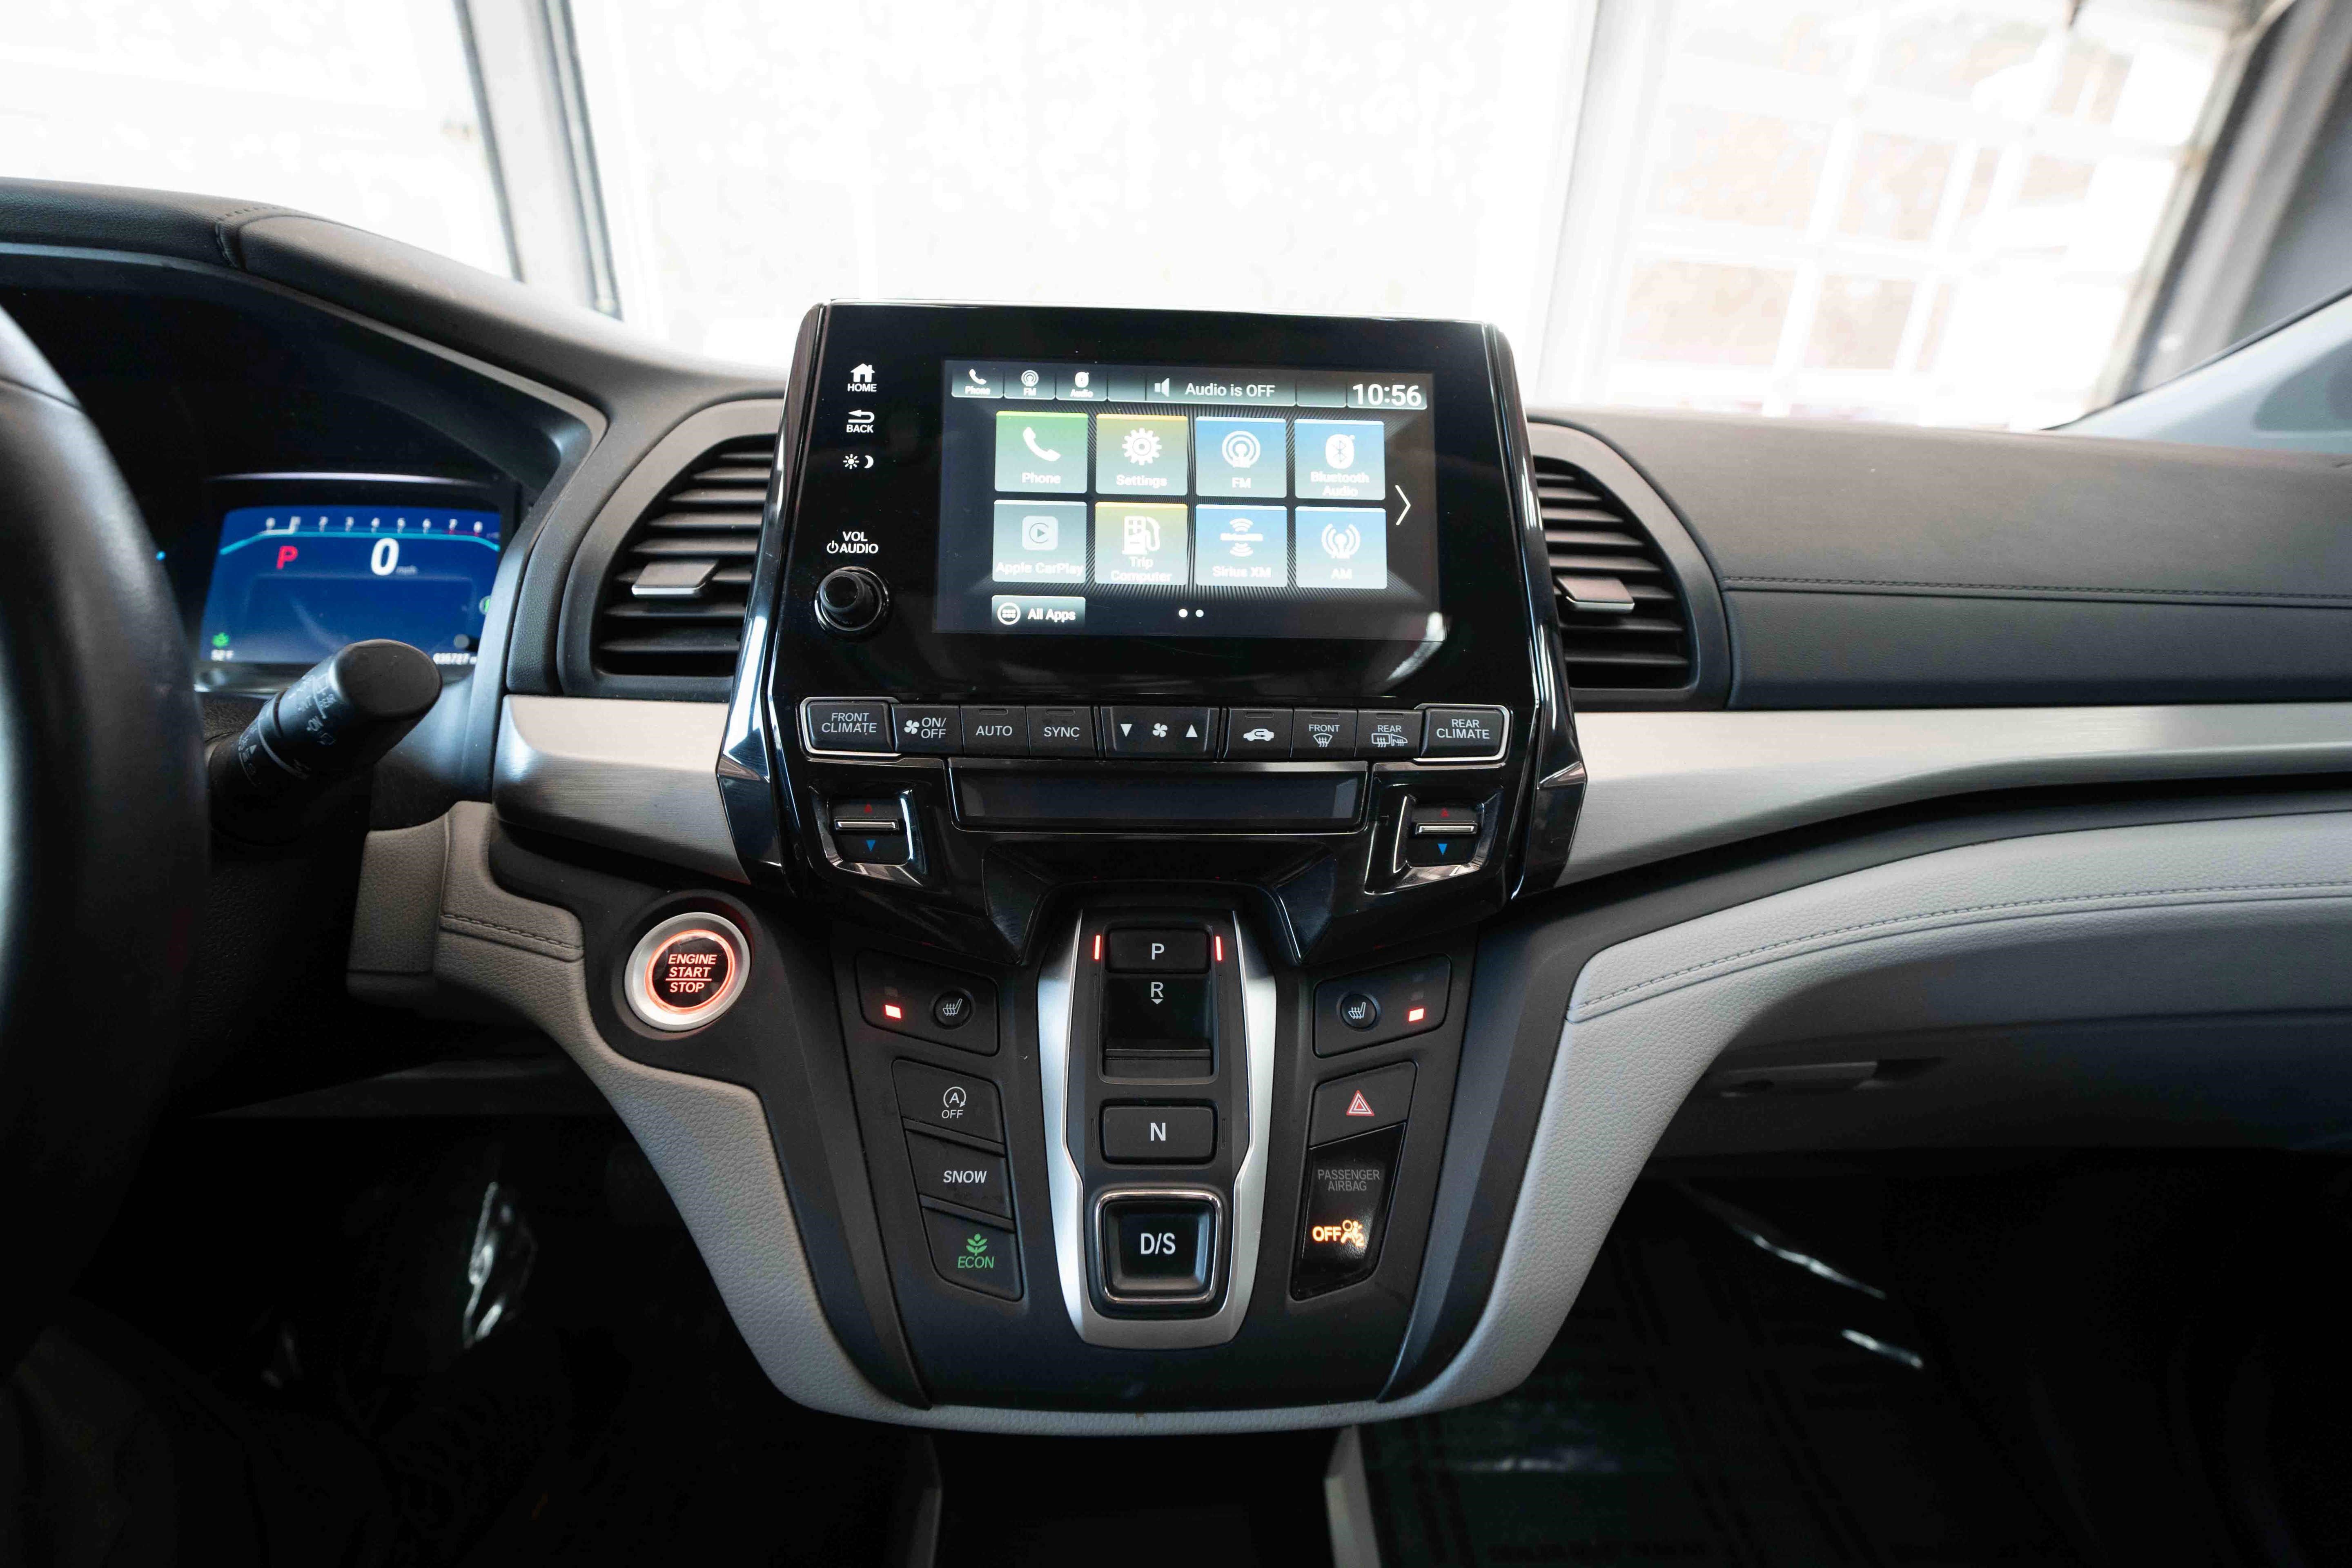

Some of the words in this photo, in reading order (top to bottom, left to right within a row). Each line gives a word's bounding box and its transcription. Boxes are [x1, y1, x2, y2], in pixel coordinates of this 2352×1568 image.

[847, 383, 877, 392] HOME
[964, 385, 991, 395] Phone
[1023, 388, 1036, 396] FM
[1185, 383, 1227, 396] Audio
[1230, 384, 1242, 396] is
[1246, 384, 1275, 397] OFF
[1069, 389, 1094, 399] Audio
[1352, 383, 1422, 406] 10:56
[846, 424, 874, 433] BACK
[1022, 472, 1061, 484] Phone
[1116, 474, 1167, 488] Settings
[1232, 477, 1252, 488] FM
[1310, 471, 1370, 484] Bluetooth
[1322, 485, 1358, 497] Audio
[842, 531, 868, 542] VOL
[839, 543, 879, 554] AUDIO
[276, 545, 298, 570] P
[371, 537, 400, 576] 0
[1129, 556, 1154, 568] Trip
[996, 562, 1031, 575] Apple
[1035, 563, 1084, 577] CarPlay
[1212, 566, 1247, 577] Sirius
[1250, 567, 1272, 578] XM
[1331, 569, 1352, 579] AM
[1110, 570, 1172, 584] Computer
[1027, 609, 1043, 619] All
[1045, 609, 1076, 622] Apps
[831, 712, 869, 722] FRONT
[921, 717, 946, 728] ON/
[821, 722, 877, 733] CLIMATE
[1308, 724, 1340, 733] FRONT
[1377, 724, 1402, 733] REAR
[1451, 719, 1480, 728] REAR
[921, 728, 946, 739] OFF
[976, 726, 1013, 736] AUTO
[1043, 726, 1080, 737] SYNC
[1436, 728, 1490, 739] CLIMATE
[1151, 943, 1165, 960] P
[668, 954, 717, 965] ENGINE
[669, 967, 711, 978] START
[669, 982, 705, 993] STOP
[1151, 982, 1163, 997] R
[949, 1093, 960, 1103] A
[941, 1109, 964, 1119] OFF
[1150, 1123, 1166, 1141] N
[943, 1170, 987, 1184] SNOW
[1318, 1169, 1380, 1180] PASSENGER
[1328, 1180, 1367, 1192] AIRBAG
[1312, 1226, 1342, 1242] OFF
[1140, 1232, 1176, 1255] D/S
[957, 1256, 995, 1269] ECON
